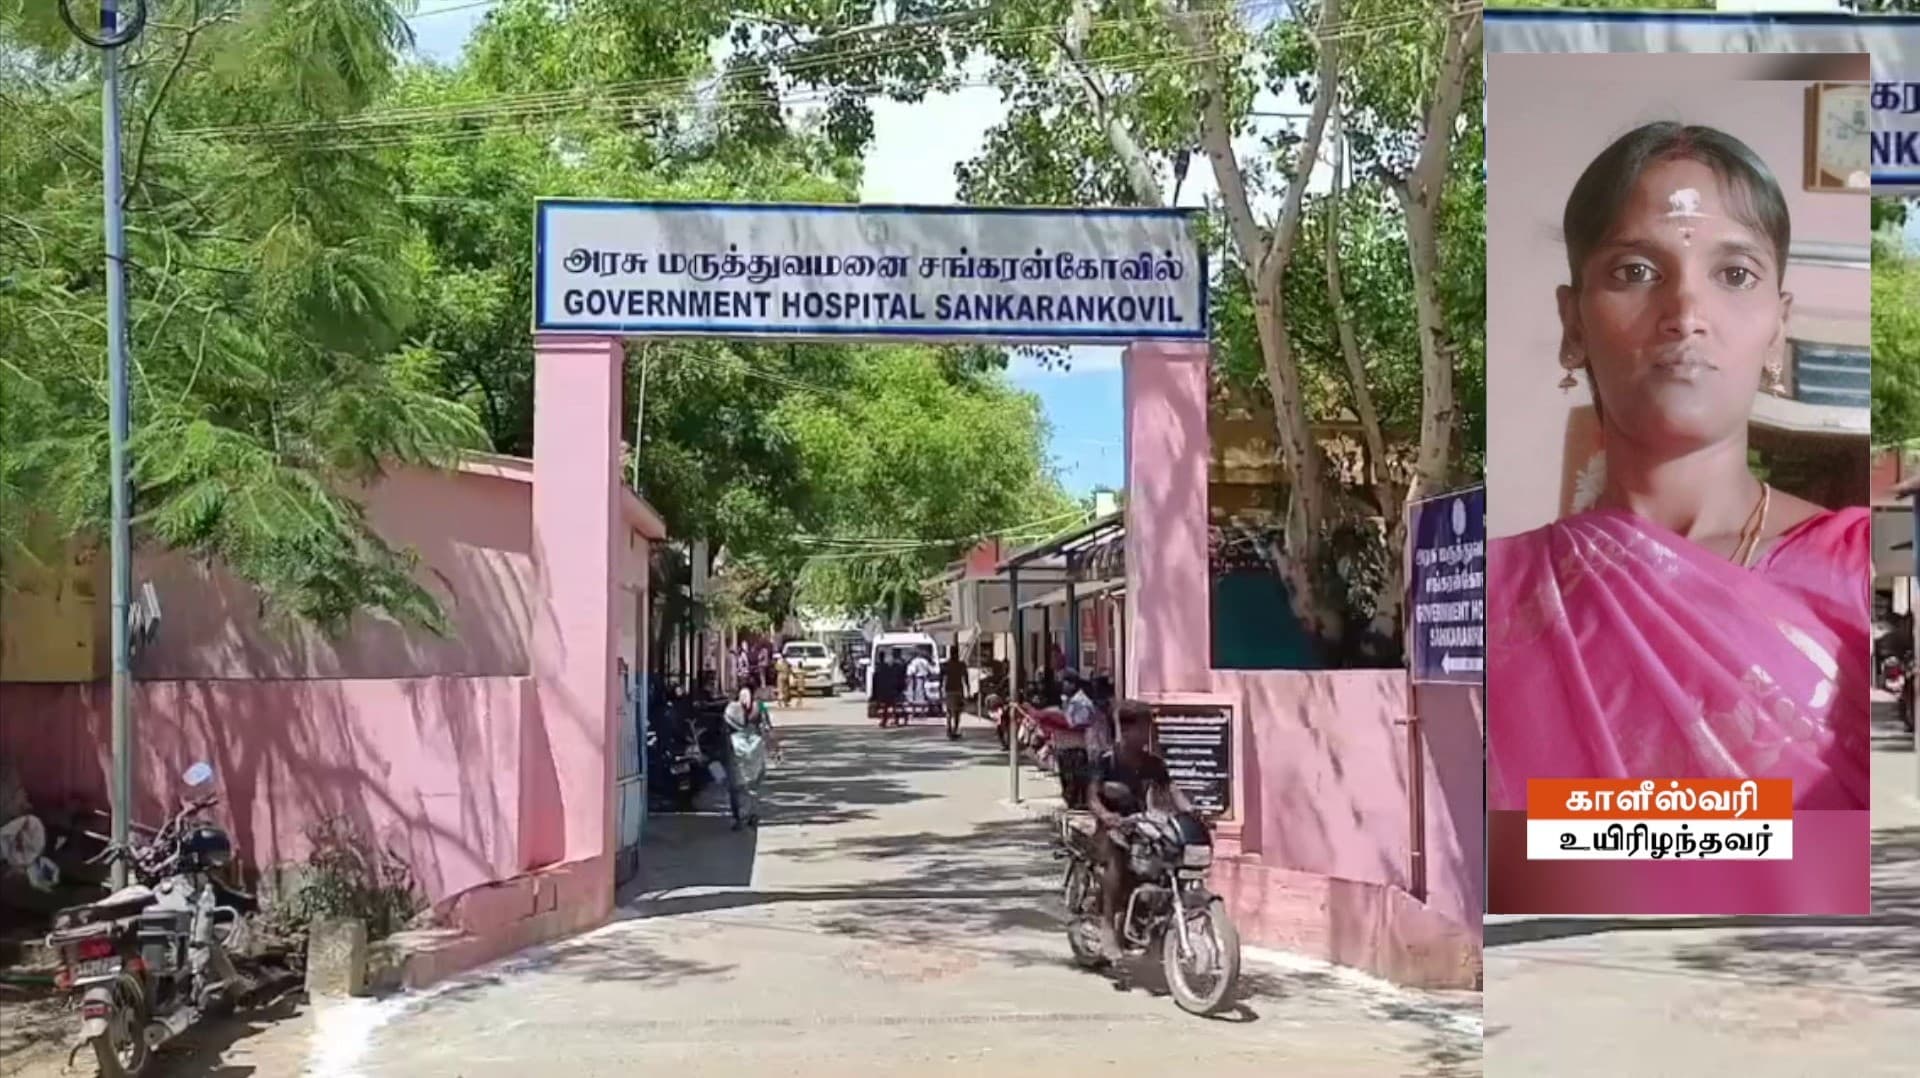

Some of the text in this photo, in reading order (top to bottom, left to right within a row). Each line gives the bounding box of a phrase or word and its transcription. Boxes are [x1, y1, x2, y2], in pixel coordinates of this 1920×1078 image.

[563, 243, 1184, 284] அரசு மருத்துவமனை சங்கரன்கோவில்
[564, 289, 1183, 323] GOVERNMENT HOSPITAL SANKARANKOVIL
